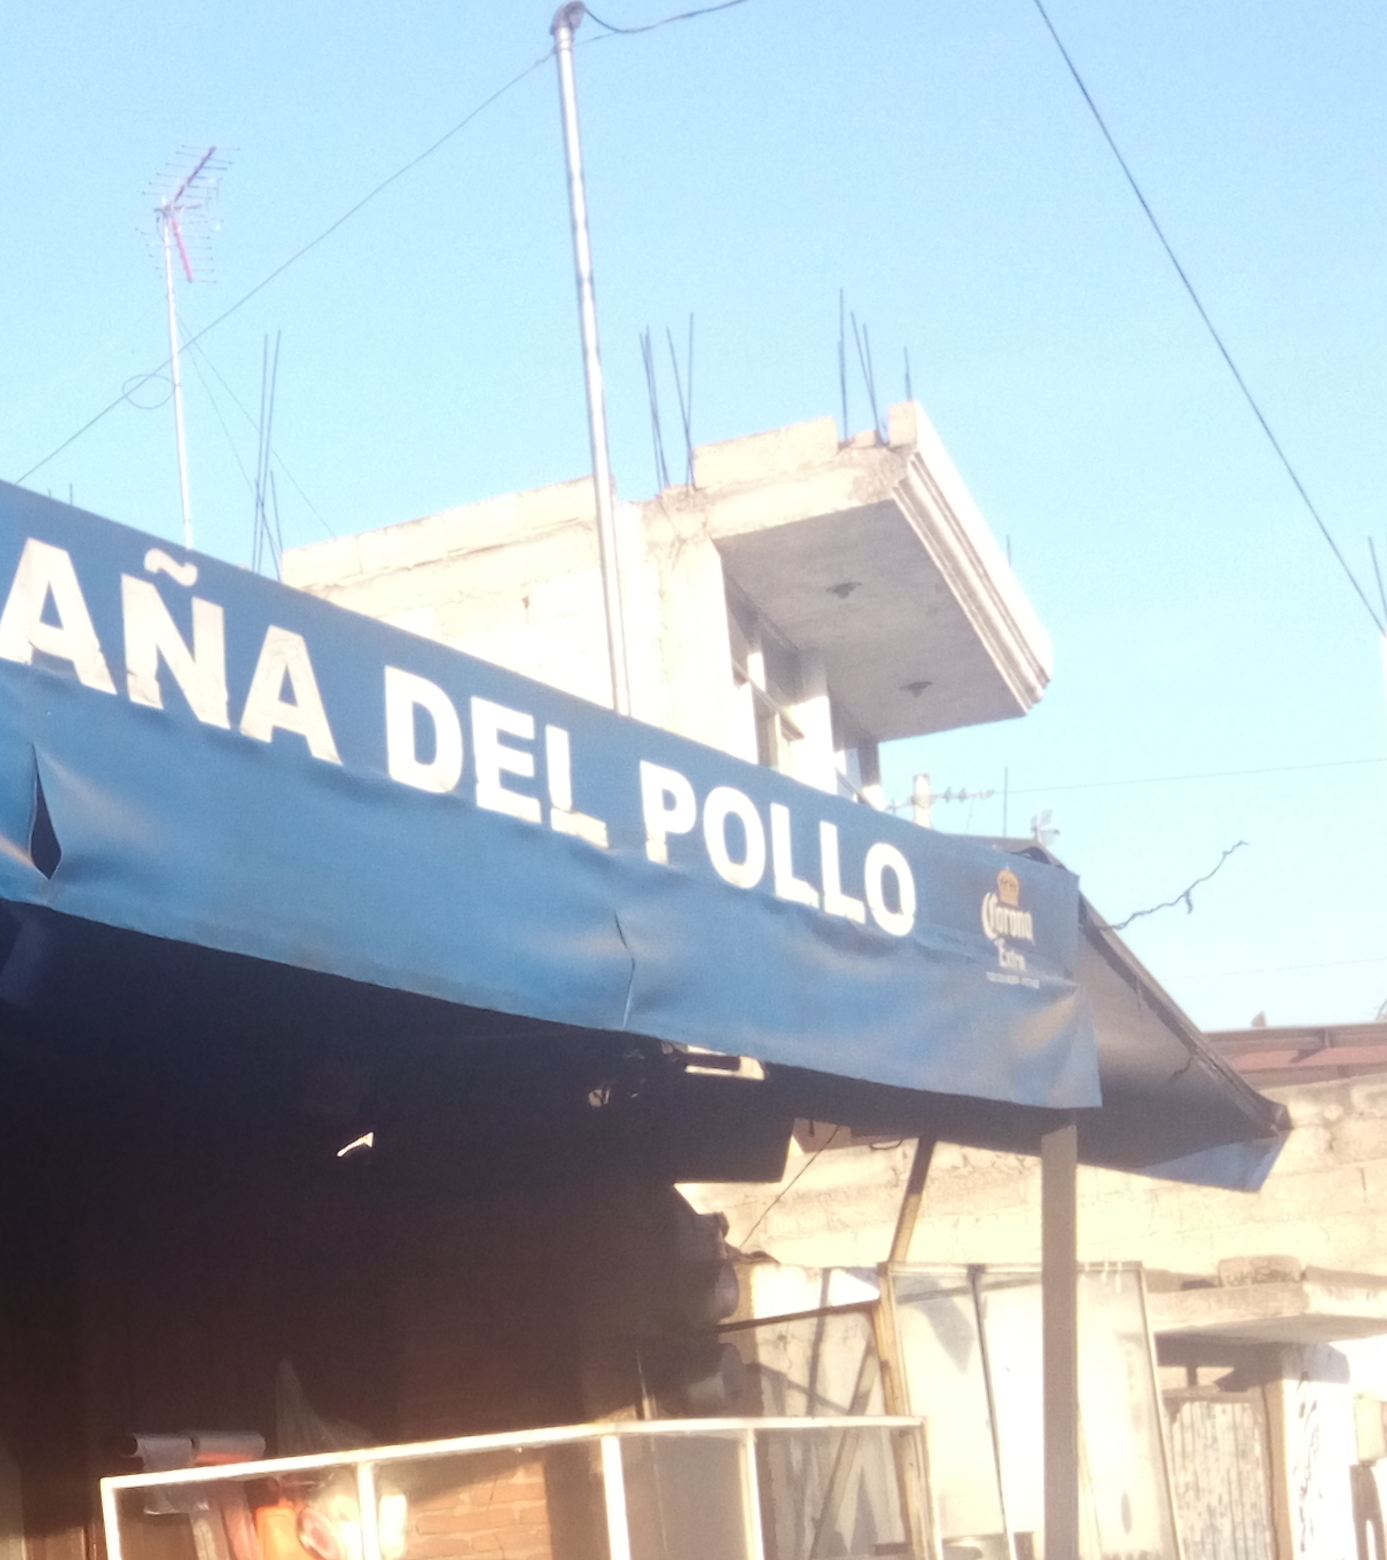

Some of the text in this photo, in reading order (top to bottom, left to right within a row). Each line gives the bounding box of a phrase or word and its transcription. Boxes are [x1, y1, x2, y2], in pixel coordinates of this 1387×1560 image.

[384, 664, 610, 850] DEL
[639, 759, 917, 937] POLLO
[981, 892, 1034, 941] Corona
